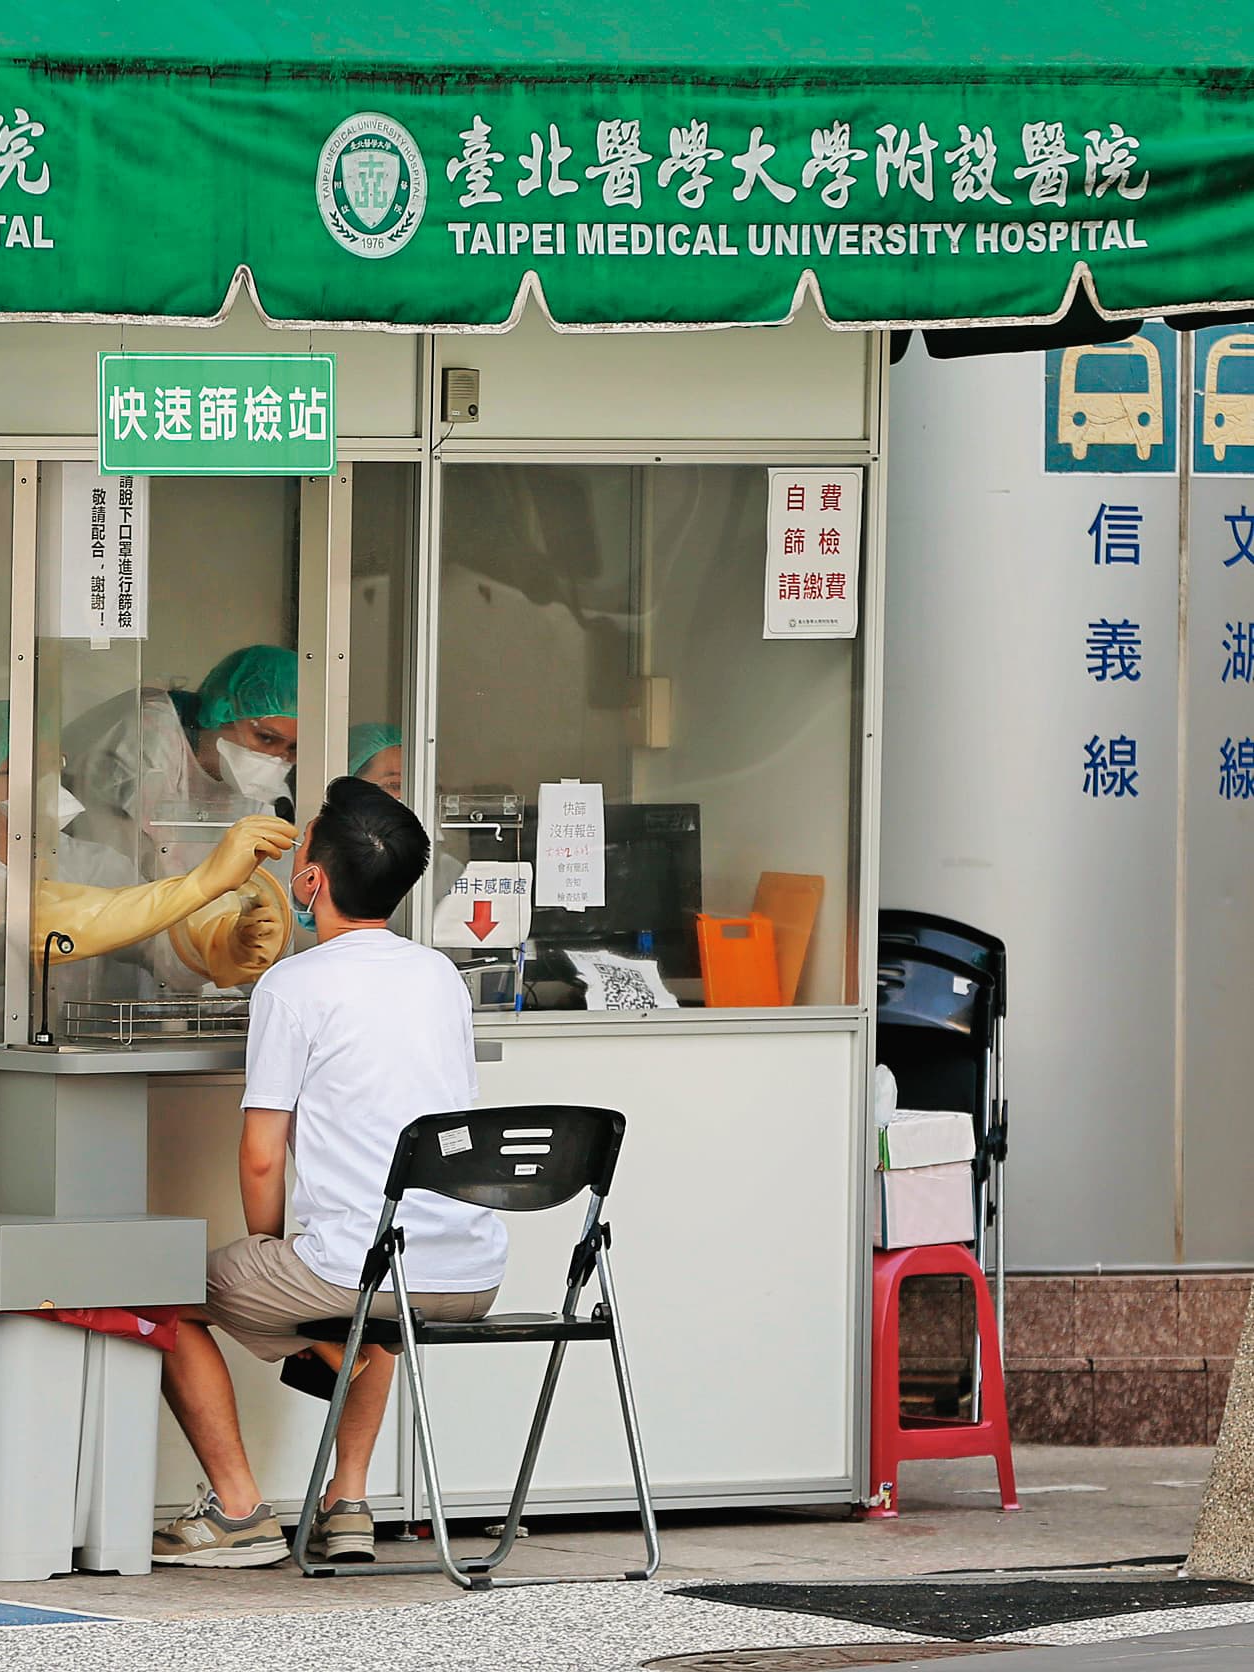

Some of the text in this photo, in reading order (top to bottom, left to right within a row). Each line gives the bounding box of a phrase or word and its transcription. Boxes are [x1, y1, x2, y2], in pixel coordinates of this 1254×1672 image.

[328, 124, 357, 162] MEDICAL
[358, 120, 407, 147] UNIVERSITY
[447, 115, 1149, 209] 臺北醫學大學附設醫院
[361, 237, 385, 249] 1976
[447, 219, 1148, 256] TAIPEI MEDICAL UNIVERSITY HOSPITAL
[109, 385, 327, 442] 快速篩檢站
[787, 484, 842, 511] 自費
[784, 528, 841, 555] 篩檢
[779, 573, 846, 600] 請繳費
[1083, 502, 1144, 798] 信義線
[549, 823, 597, 839] 沒有報告
[444, 877, 527, 897] 用卡感應處
